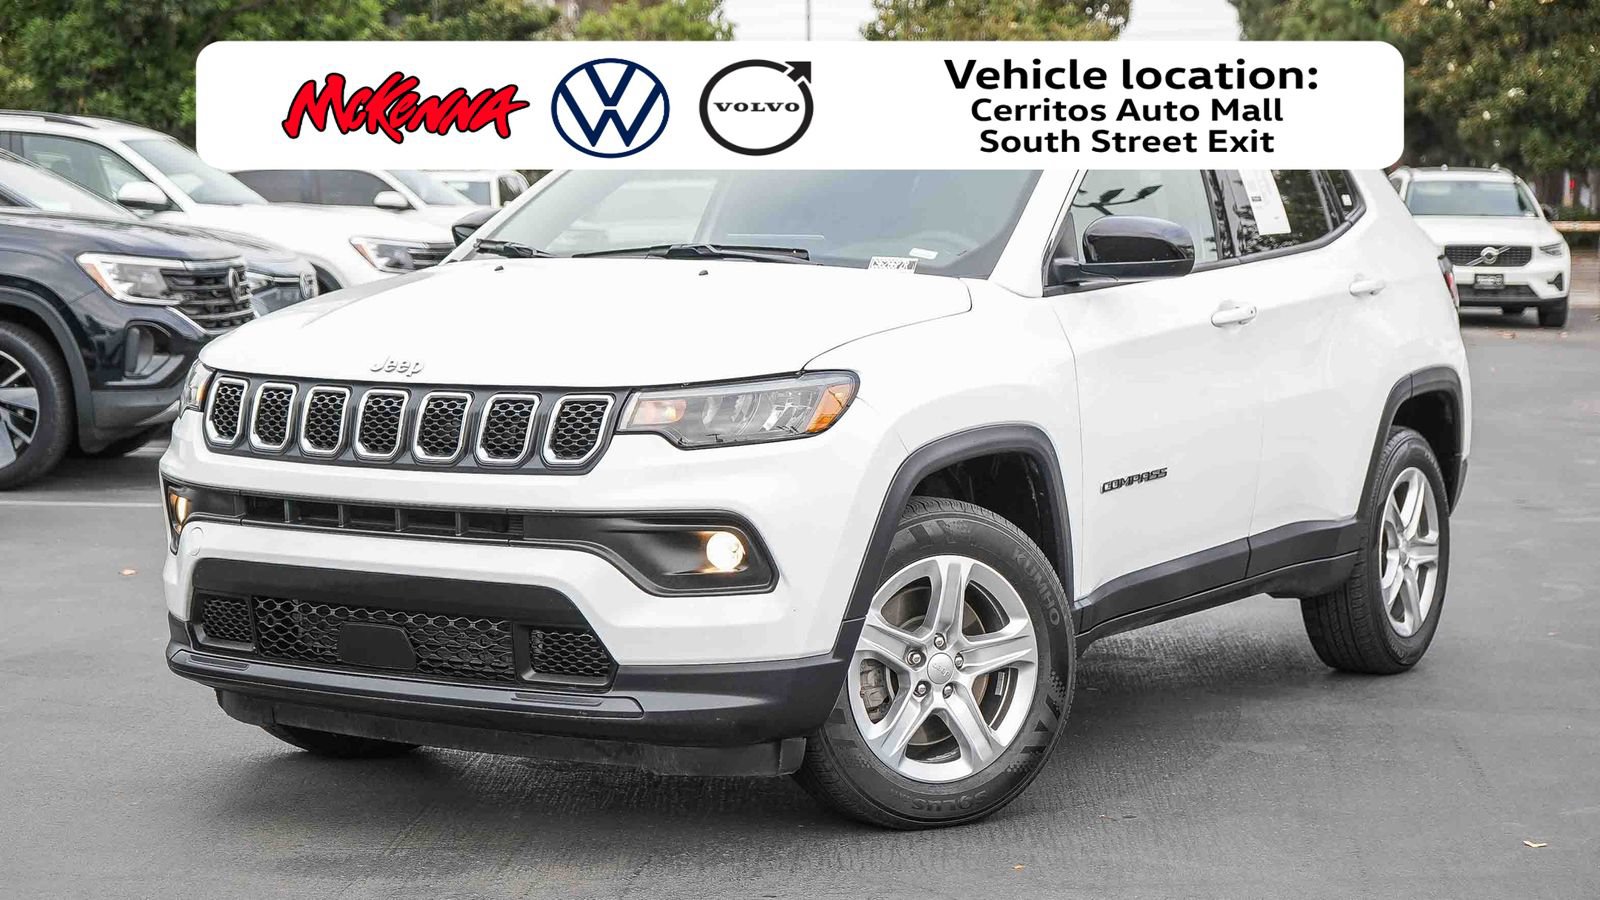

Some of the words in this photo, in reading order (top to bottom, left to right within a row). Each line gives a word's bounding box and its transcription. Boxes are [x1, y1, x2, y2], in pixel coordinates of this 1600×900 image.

[369, 355, 424, 378] Jeep
[1100, 467, 1168, 494] COMPASS
[1013, 547, 1061, 627] KUMHO
